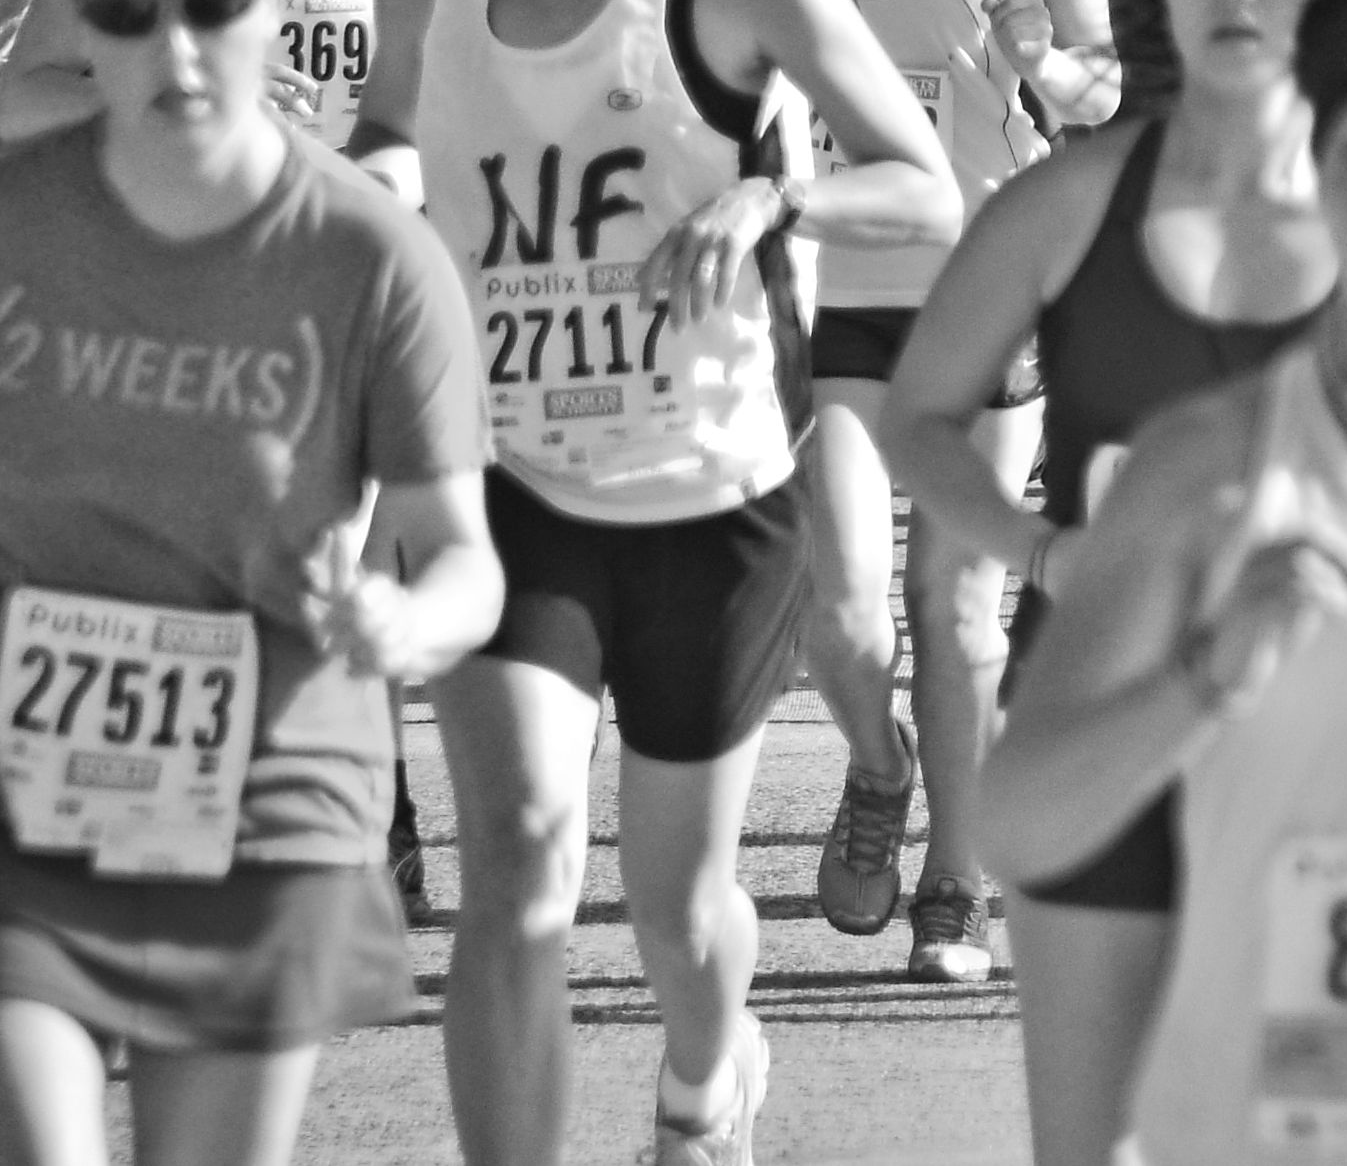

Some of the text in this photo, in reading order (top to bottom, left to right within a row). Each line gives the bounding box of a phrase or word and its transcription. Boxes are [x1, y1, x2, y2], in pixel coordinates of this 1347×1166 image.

[478, 143, 647, 270] NF
[486, 274, 578, 300] Publix
[486, 300, 670, 386] 27117
[26, 601, 140, 645] Publix
[11, 644, 237, 750] 27513
